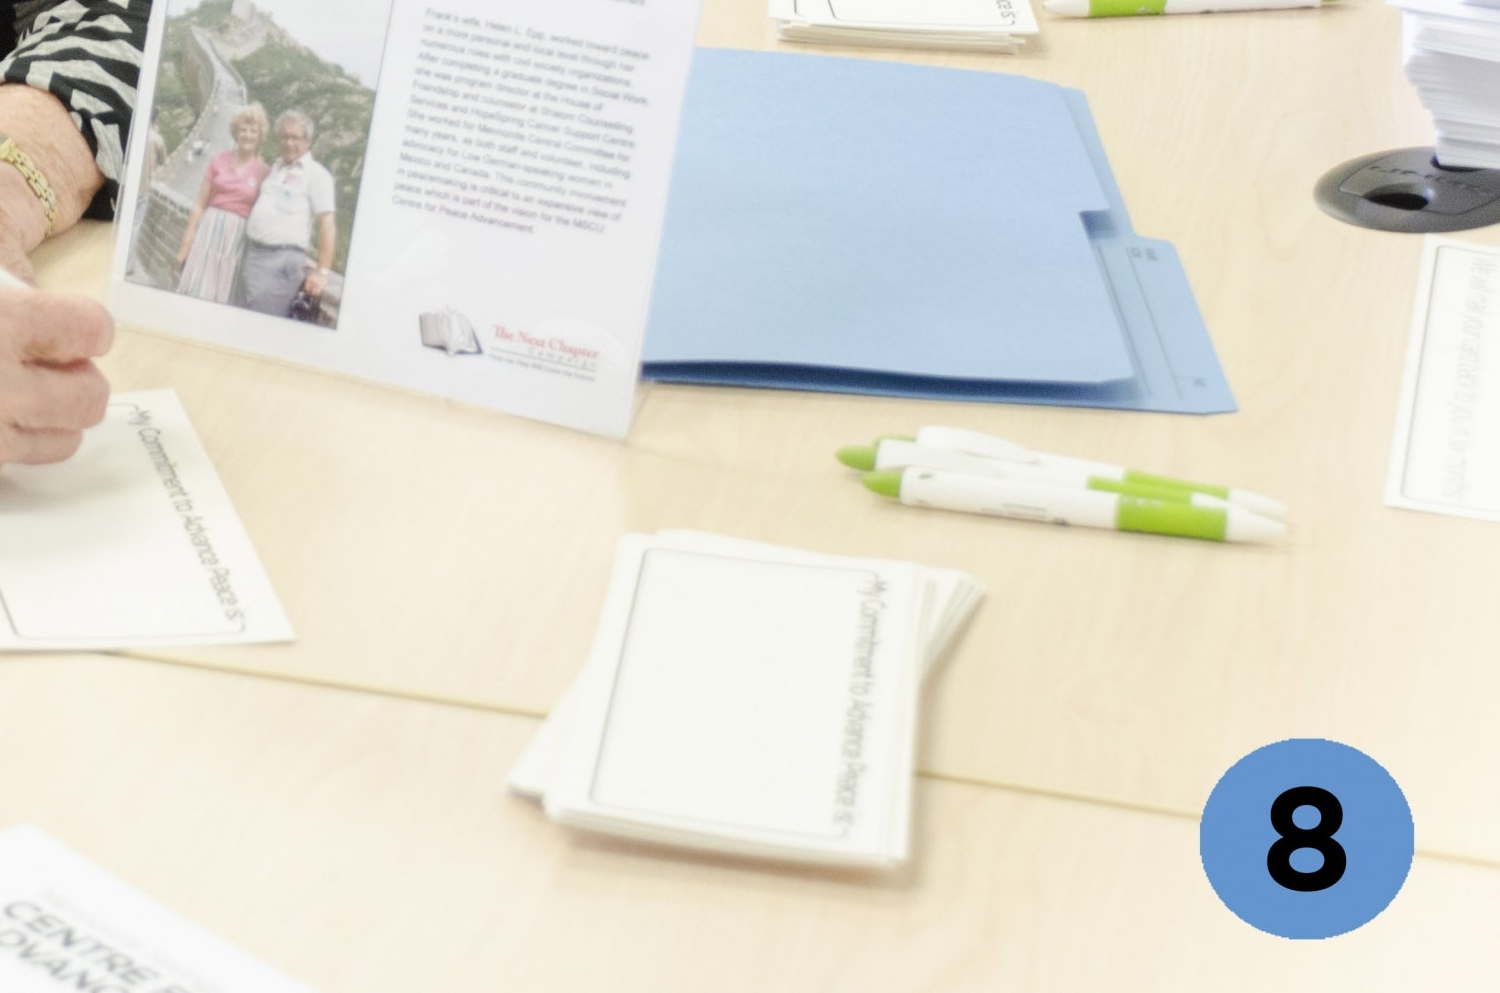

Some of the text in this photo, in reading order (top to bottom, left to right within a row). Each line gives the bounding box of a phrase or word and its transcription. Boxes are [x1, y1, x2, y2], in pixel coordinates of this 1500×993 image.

[491, 324, 599, 362] The Next Chapter
[128, 409, 153, 427] My
[138, 426, 188, 498] Commitment
[173, 498, 194, 512] to
[182, 514, 219, 566] Advance
[209, 567, 238, 606] Peace
[857, 578, 889, 598] My
[851, 598, 888, 680] Commitment
[850, 681, 875, 697] to
[841, 699, 873, 760] Advance
[835, 761, 867, 808] Peace
[3, 900, 160, 986] CENTRE
